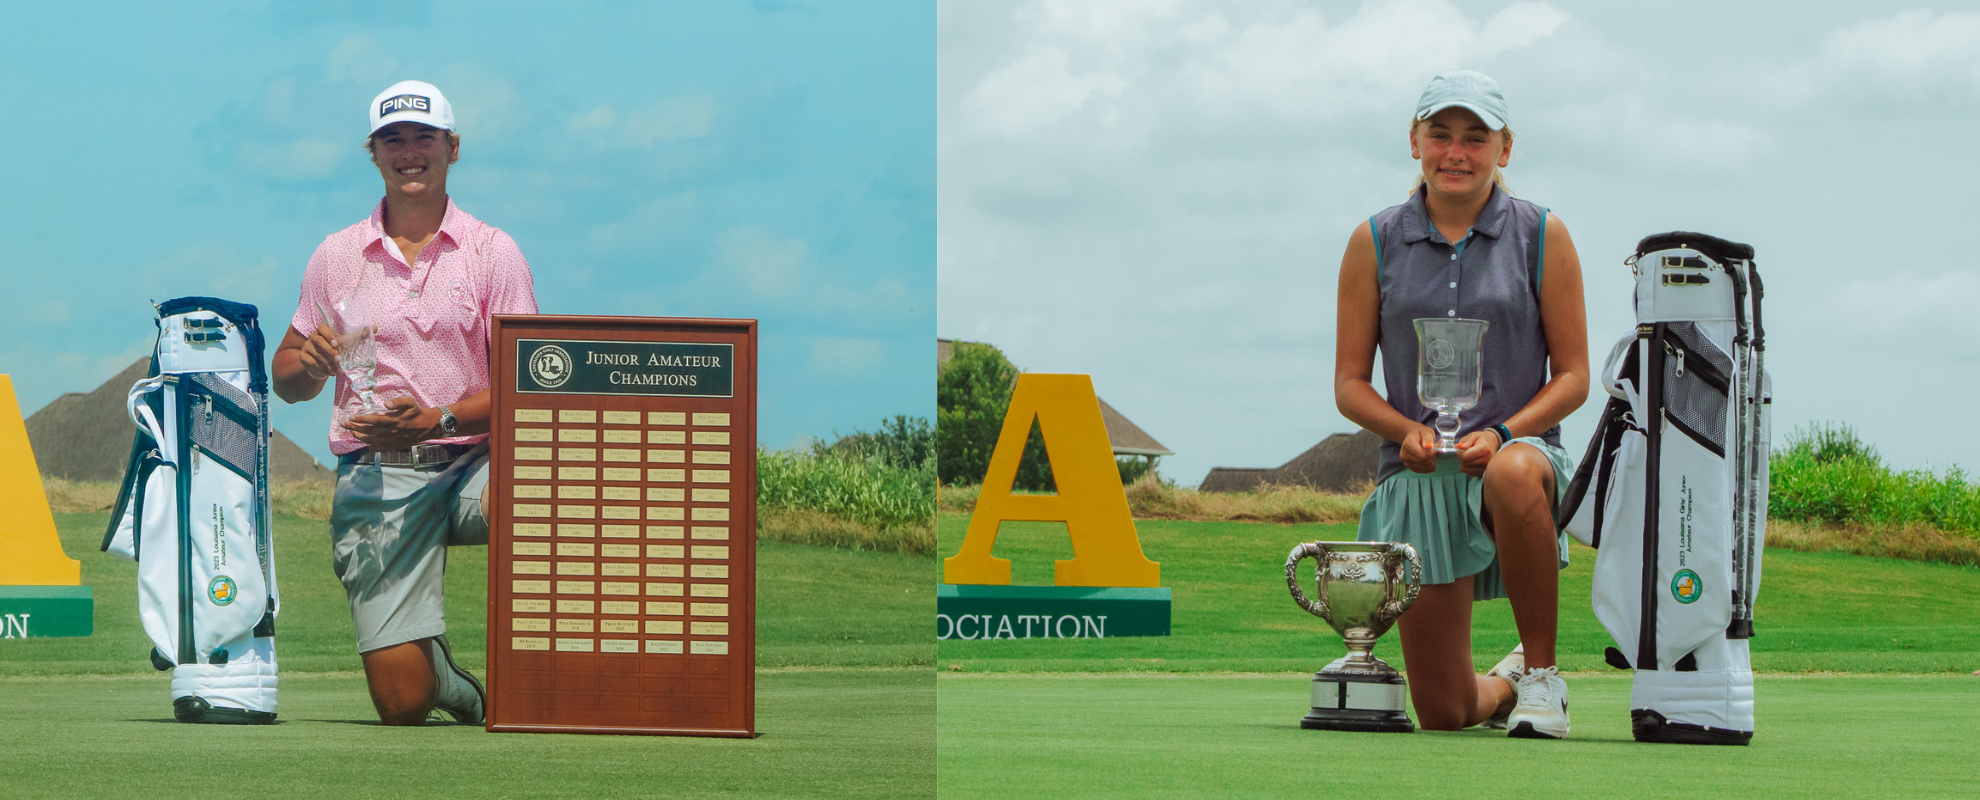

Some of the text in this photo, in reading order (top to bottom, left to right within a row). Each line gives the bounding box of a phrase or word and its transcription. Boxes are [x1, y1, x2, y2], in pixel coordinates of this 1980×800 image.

[382, 97, 427, 114] PING
[586, 351, 721, 368] JUNIOR AMATEUR
[609, 370, 697, 386] CHAMPIONS
[944, 374, 1160, 588] A
[0, 614, 30, 639] N
